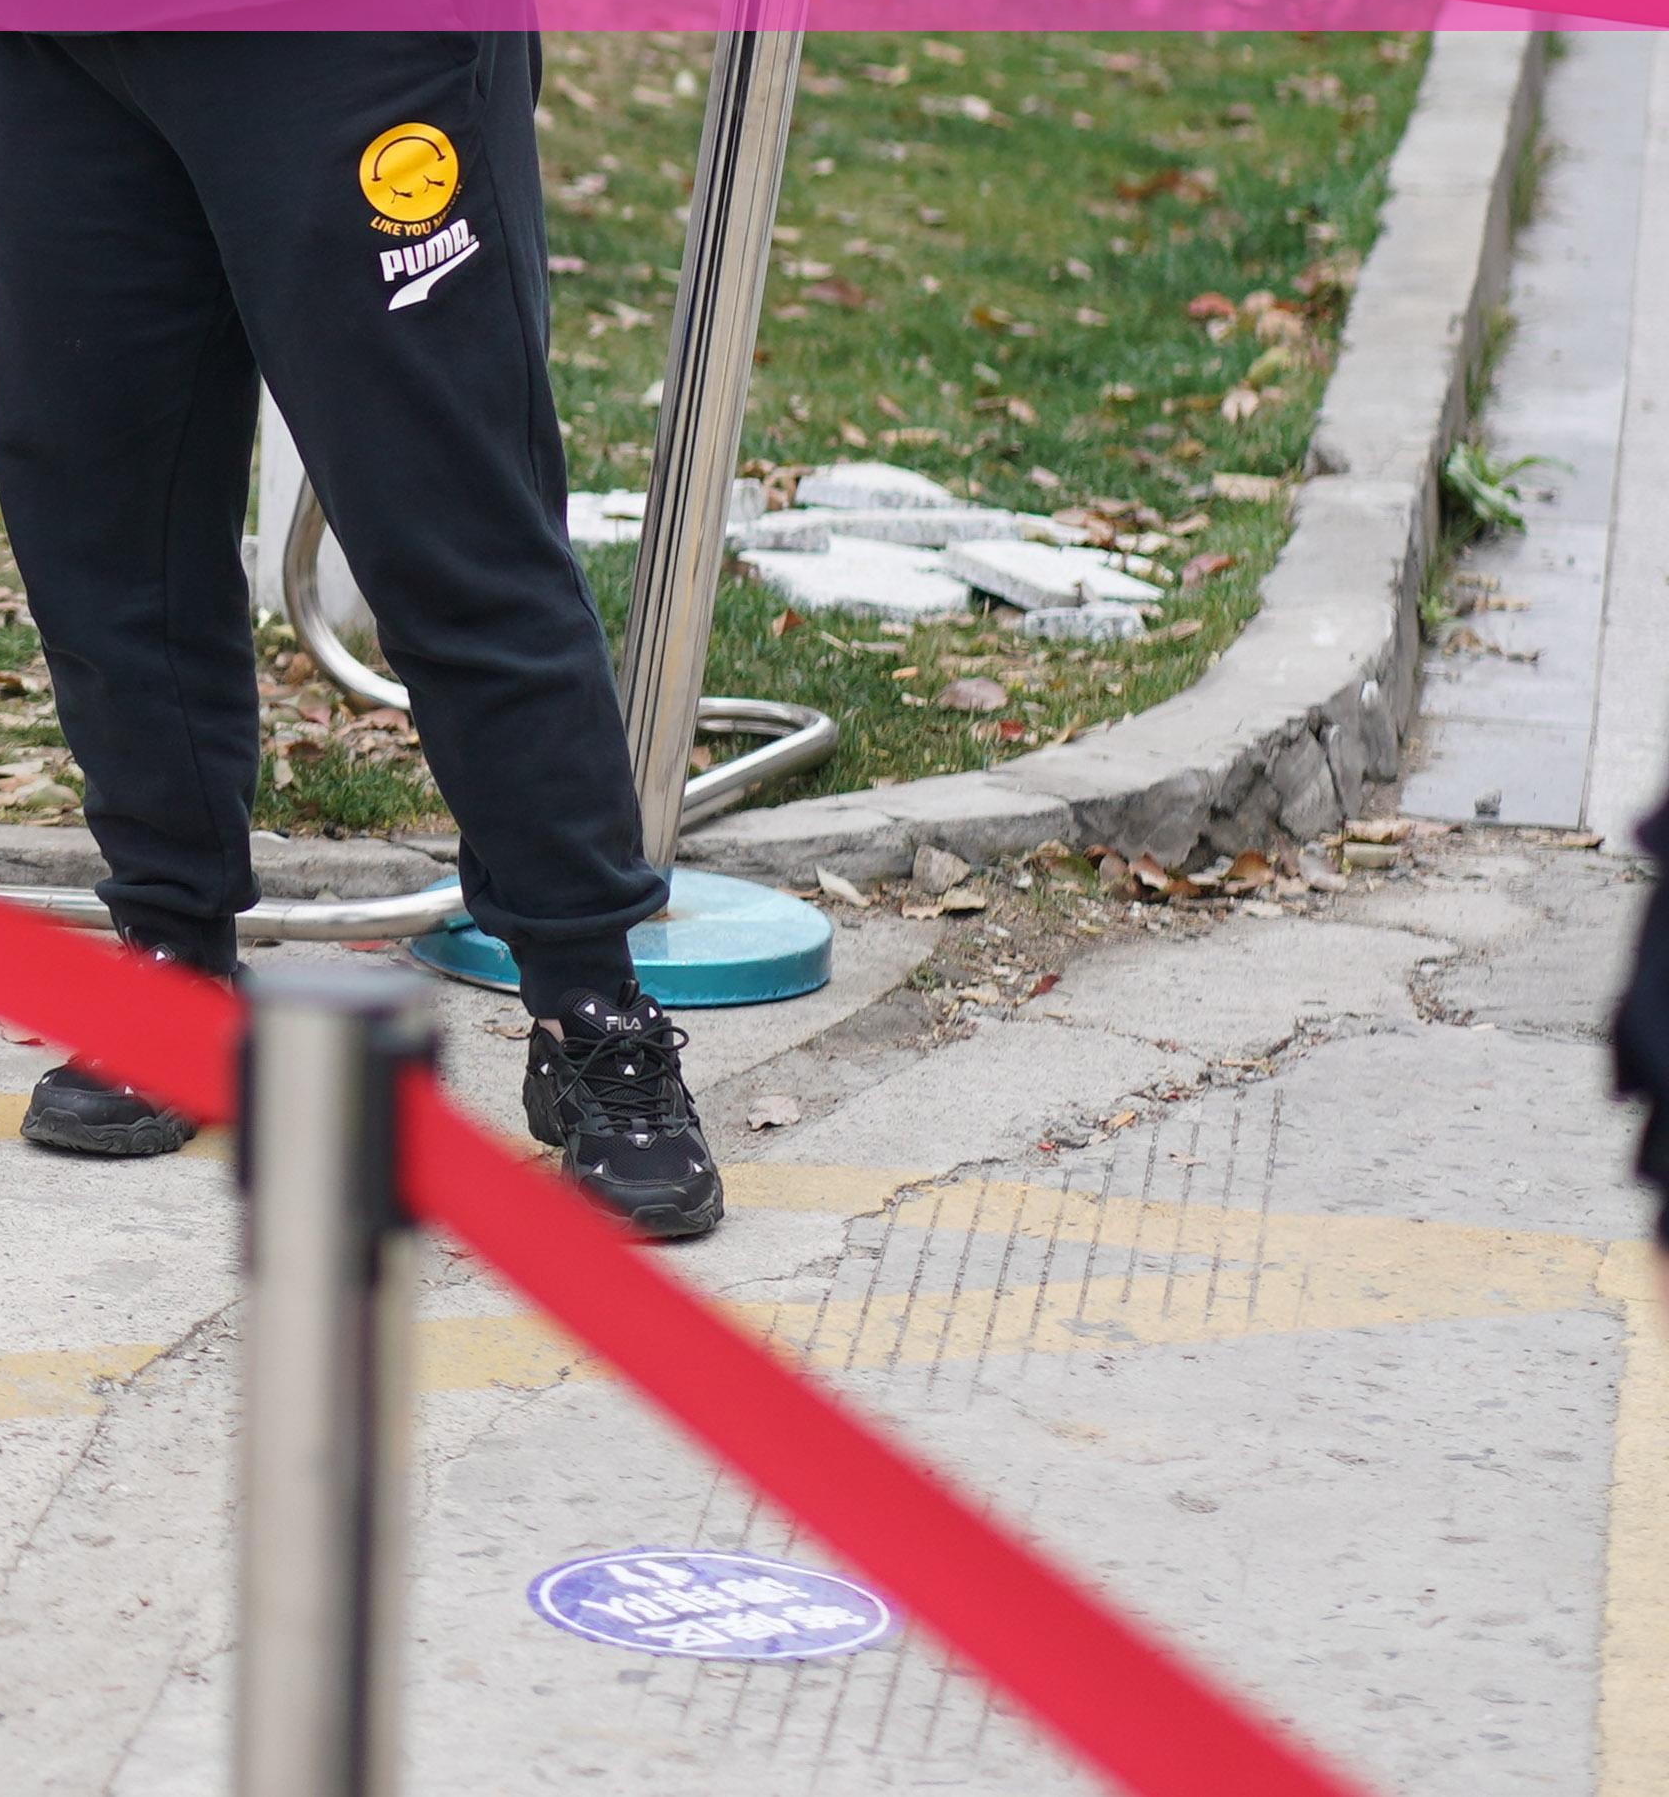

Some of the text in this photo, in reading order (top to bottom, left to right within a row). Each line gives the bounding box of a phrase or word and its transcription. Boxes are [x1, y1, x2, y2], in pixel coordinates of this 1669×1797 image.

[370, 215, 431, 237] LIKE YOU
[379, 217, 470, 282] PUMA
[605, 1015, 642, 1032] FILA
